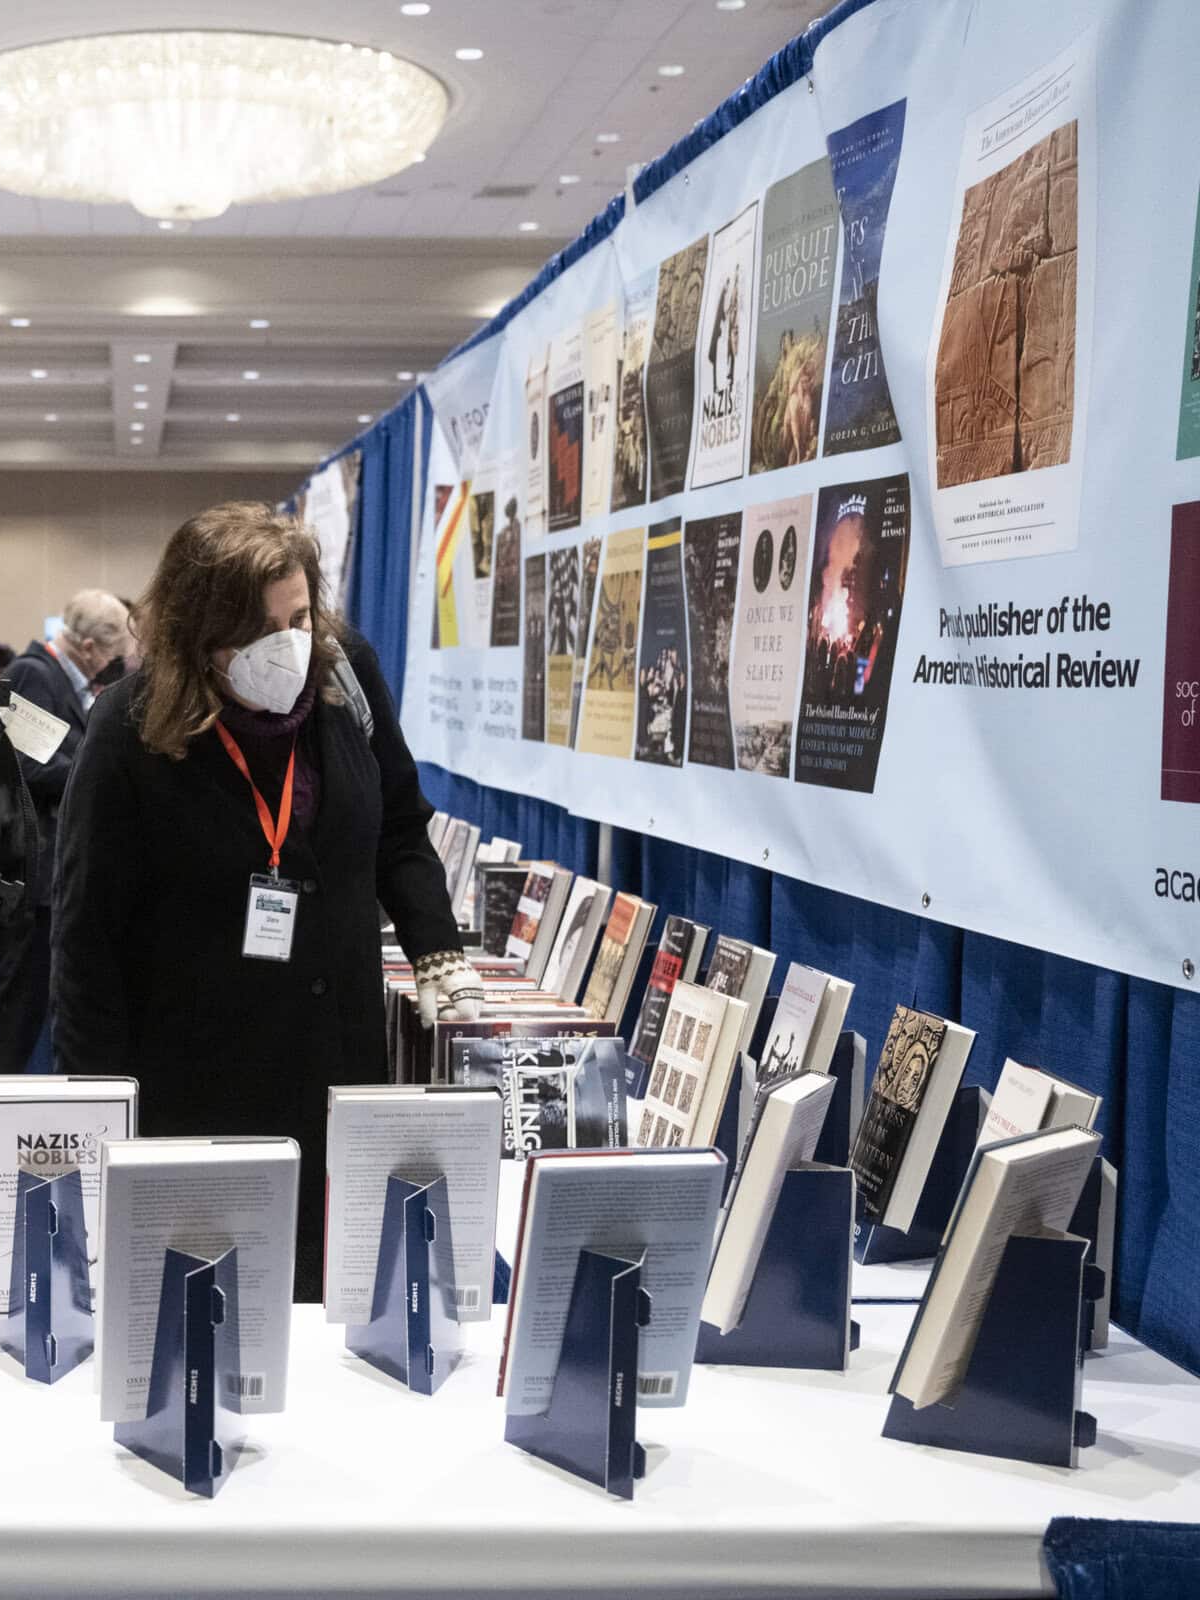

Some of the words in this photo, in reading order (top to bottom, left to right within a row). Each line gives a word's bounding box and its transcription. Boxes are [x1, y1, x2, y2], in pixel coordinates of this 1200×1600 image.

[764, 223, 834, 282] PURSUIT
[762, 256, 830, 312] EUROPE
[703, 387, 734, 425] NAZIS
[700, 414, 742, 453] NOBLES
[746, 606, 774, 625] ONCE
[779, 604, 794, 623] WE
[965, 601, 1043, 645] publisher
[1047, 596, 1069, 634] of
[1072, 594, 1111, 632] the
[753, 635, 783, 652] WERE
[745, 664, 784, 682] SLAVES
[913, 653, 976, 686] American
[976, 652, 1050, 688] Historical
[1057, 650, 1140, 688] Review
[1181, 698, 1196, 726] of
[502, 1049, 516, 1151] STRANGERS
[517, 1048, 542, 1151] KLLING
[17, 1134, 79, 1149] NAZIS
[82, 1125, 108, 1149] &
[17, 1150, 98, 1165] NOBLES
[190, 1369, 198, 1404] AECH12
